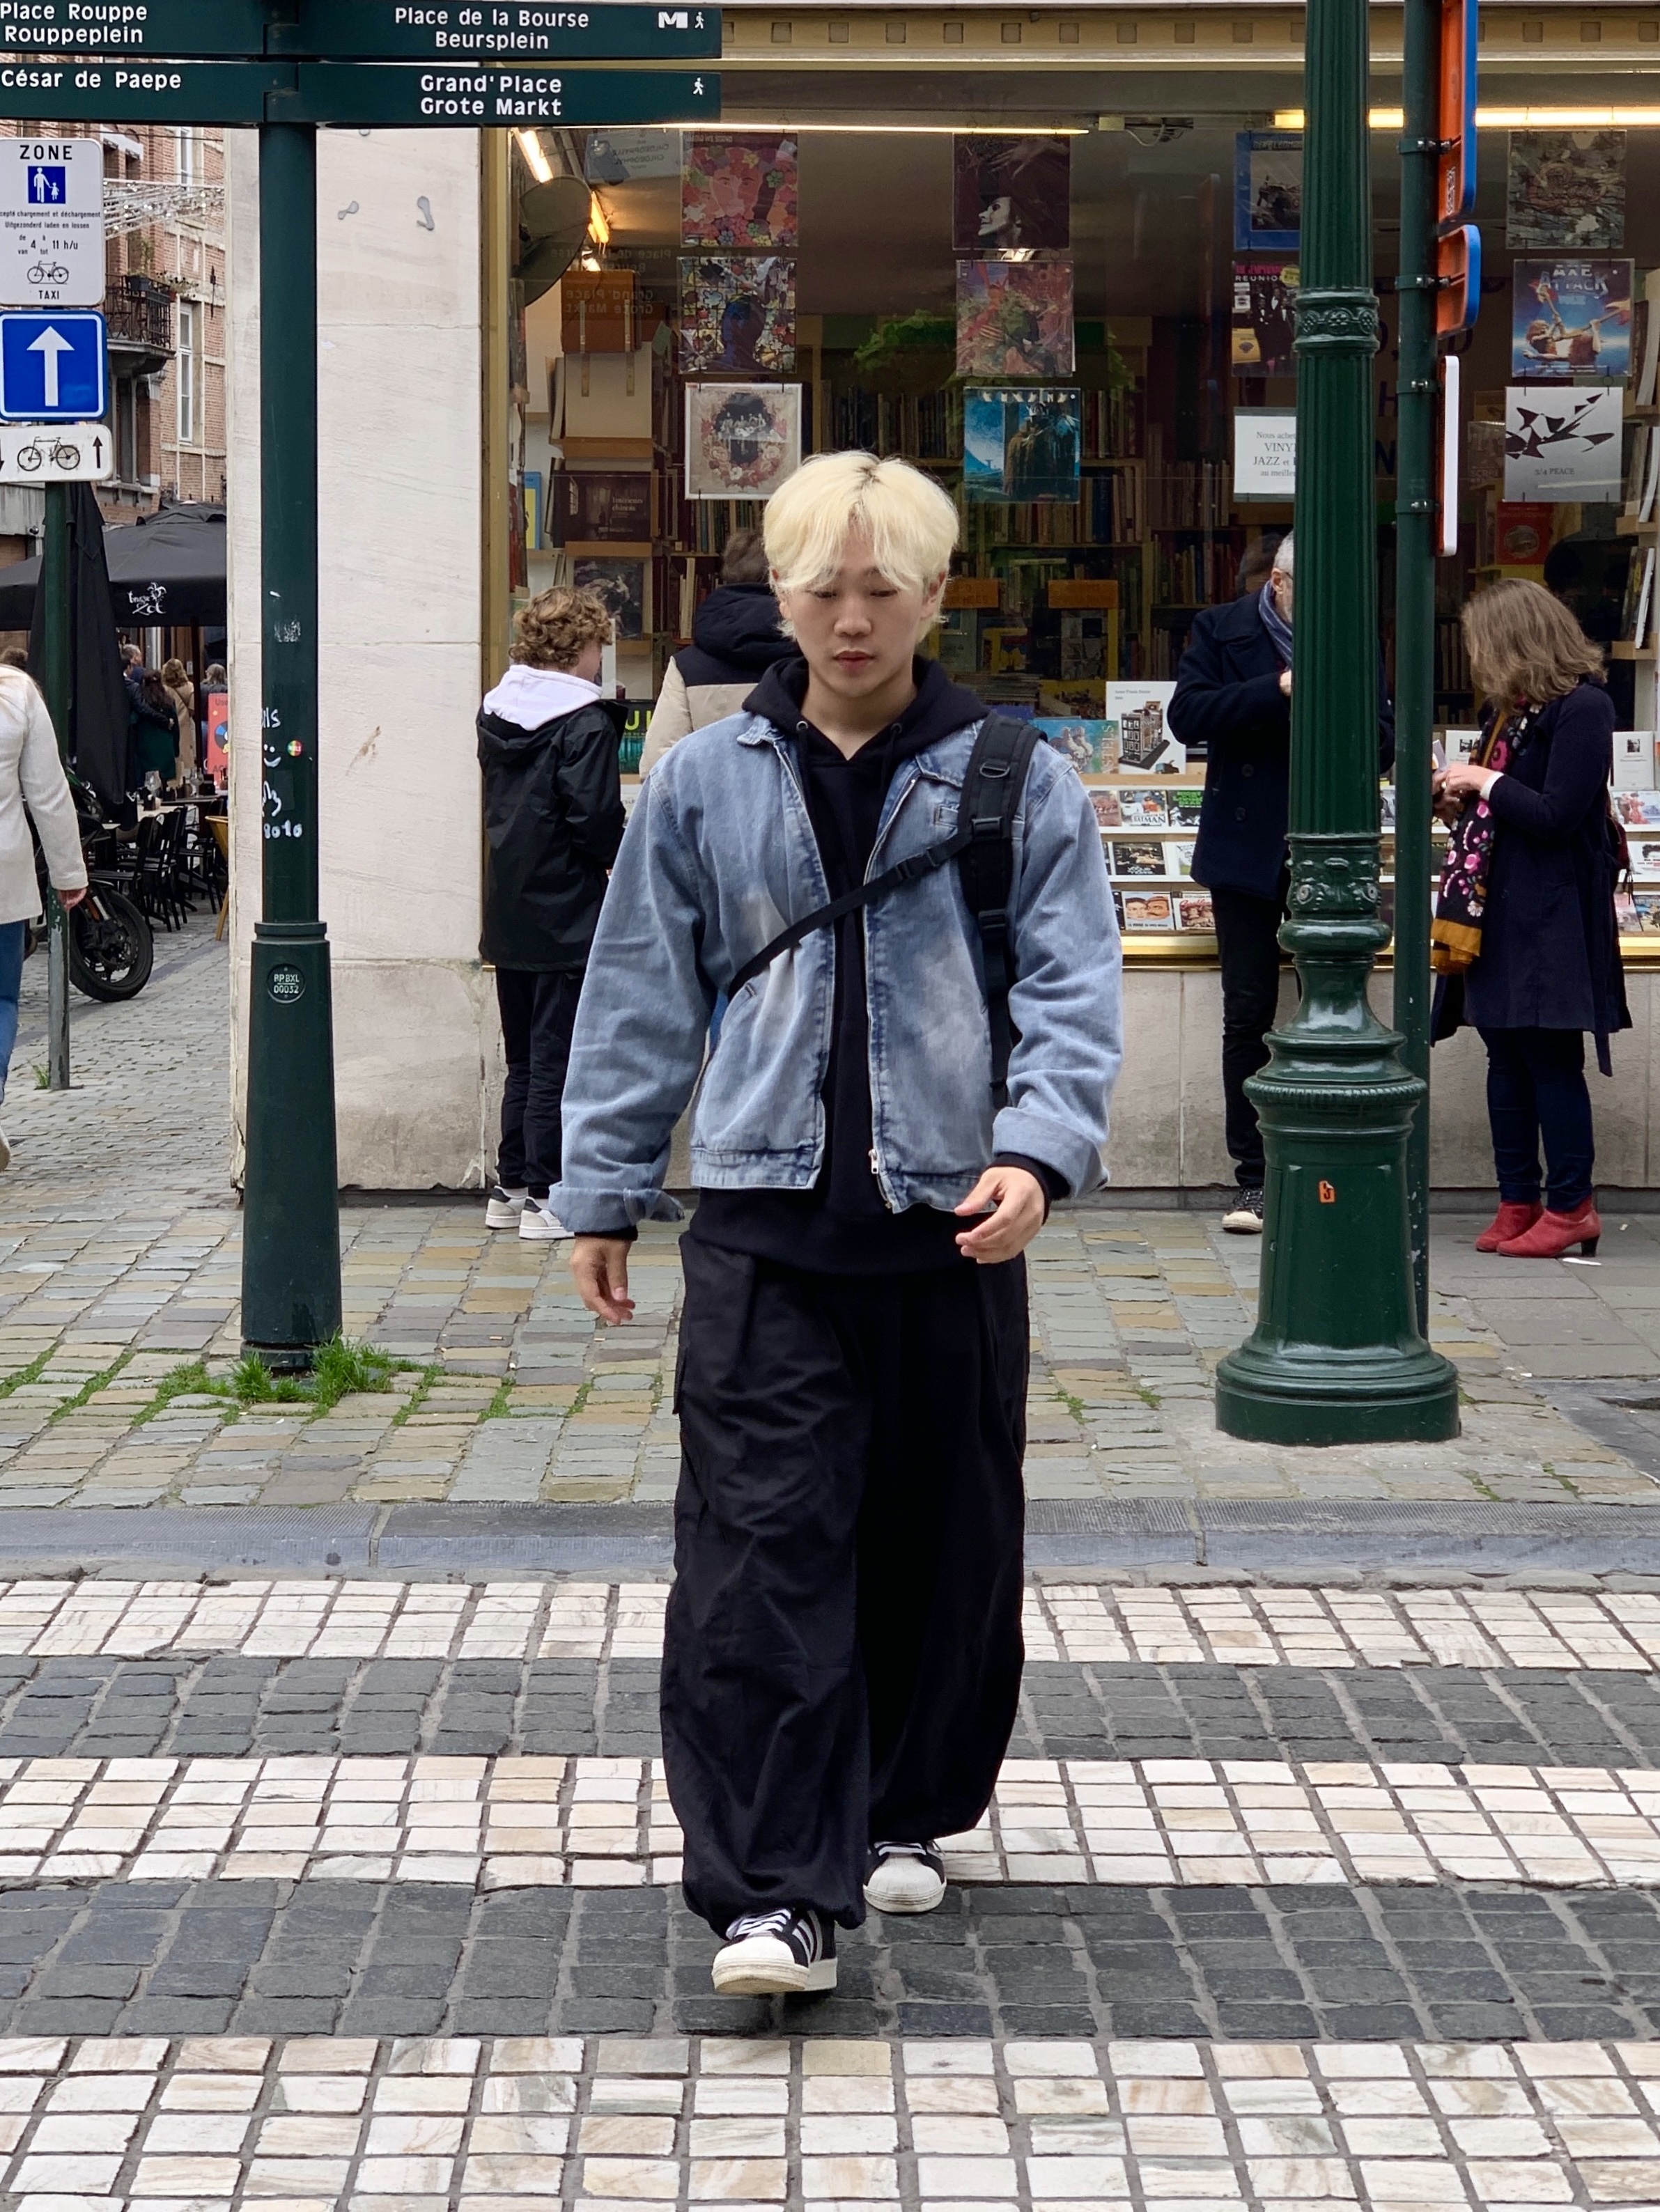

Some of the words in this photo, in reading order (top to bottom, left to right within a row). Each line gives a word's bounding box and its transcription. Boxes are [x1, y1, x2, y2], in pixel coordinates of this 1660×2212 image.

[0, 2, 55, 21] Place
[69, 3, 148, 24] Rouppe
[395, 7, 448, 26] Place
[459, 8, 482, 26] de
[492, 9, 509, 26] la
[519, 10, 589, 28] Bourse
[5, 26, 143, 44] Rouppeplein
[435, 31, 549, 51] Beursplein
[1, 69, 63, 88] César
[75, 72, 101, 89] de
[116, 71, 182, 91] Paepe
[421, 98, 484, 116] Grote
[496, 98, 561, 117] Markt
[20, 145, 72, 160] ZONE
[61, 210, 101, 219] déchargement
[31, 240, 36, 249] 4
[52, 240, 59, 249] 11
[63, 240, 78, 250] h/u
[38, 290, 60, 299] TAXI
[1252, 457, 1280, 466] JAZZ
[274, 985, 299, 994] 00032
